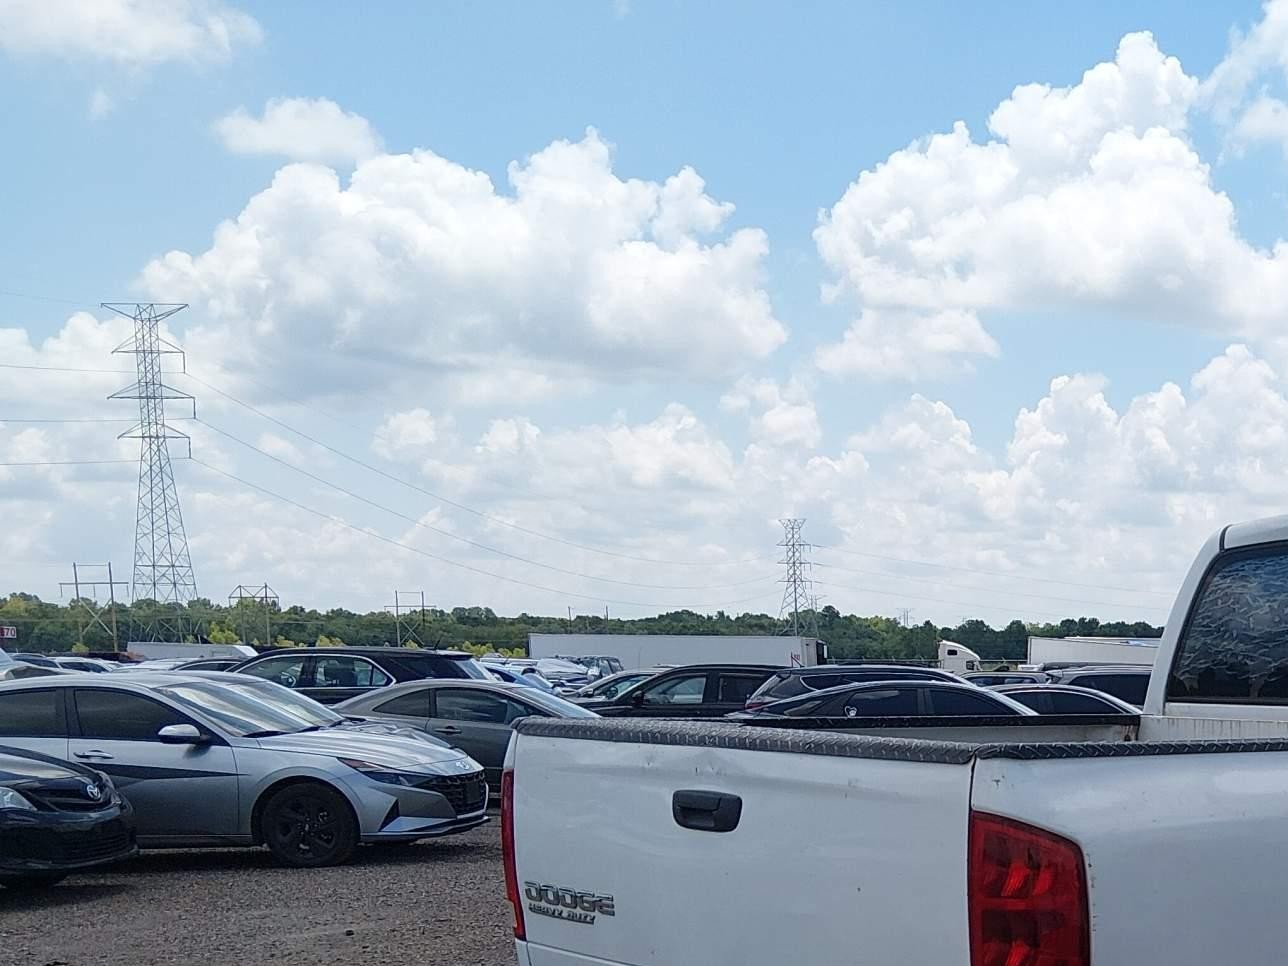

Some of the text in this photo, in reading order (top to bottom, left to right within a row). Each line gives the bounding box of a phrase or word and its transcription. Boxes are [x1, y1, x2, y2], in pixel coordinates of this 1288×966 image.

[524, 880, 616, 917] DODGE
[528, 902, 597, 923] HEAVY DUTY
